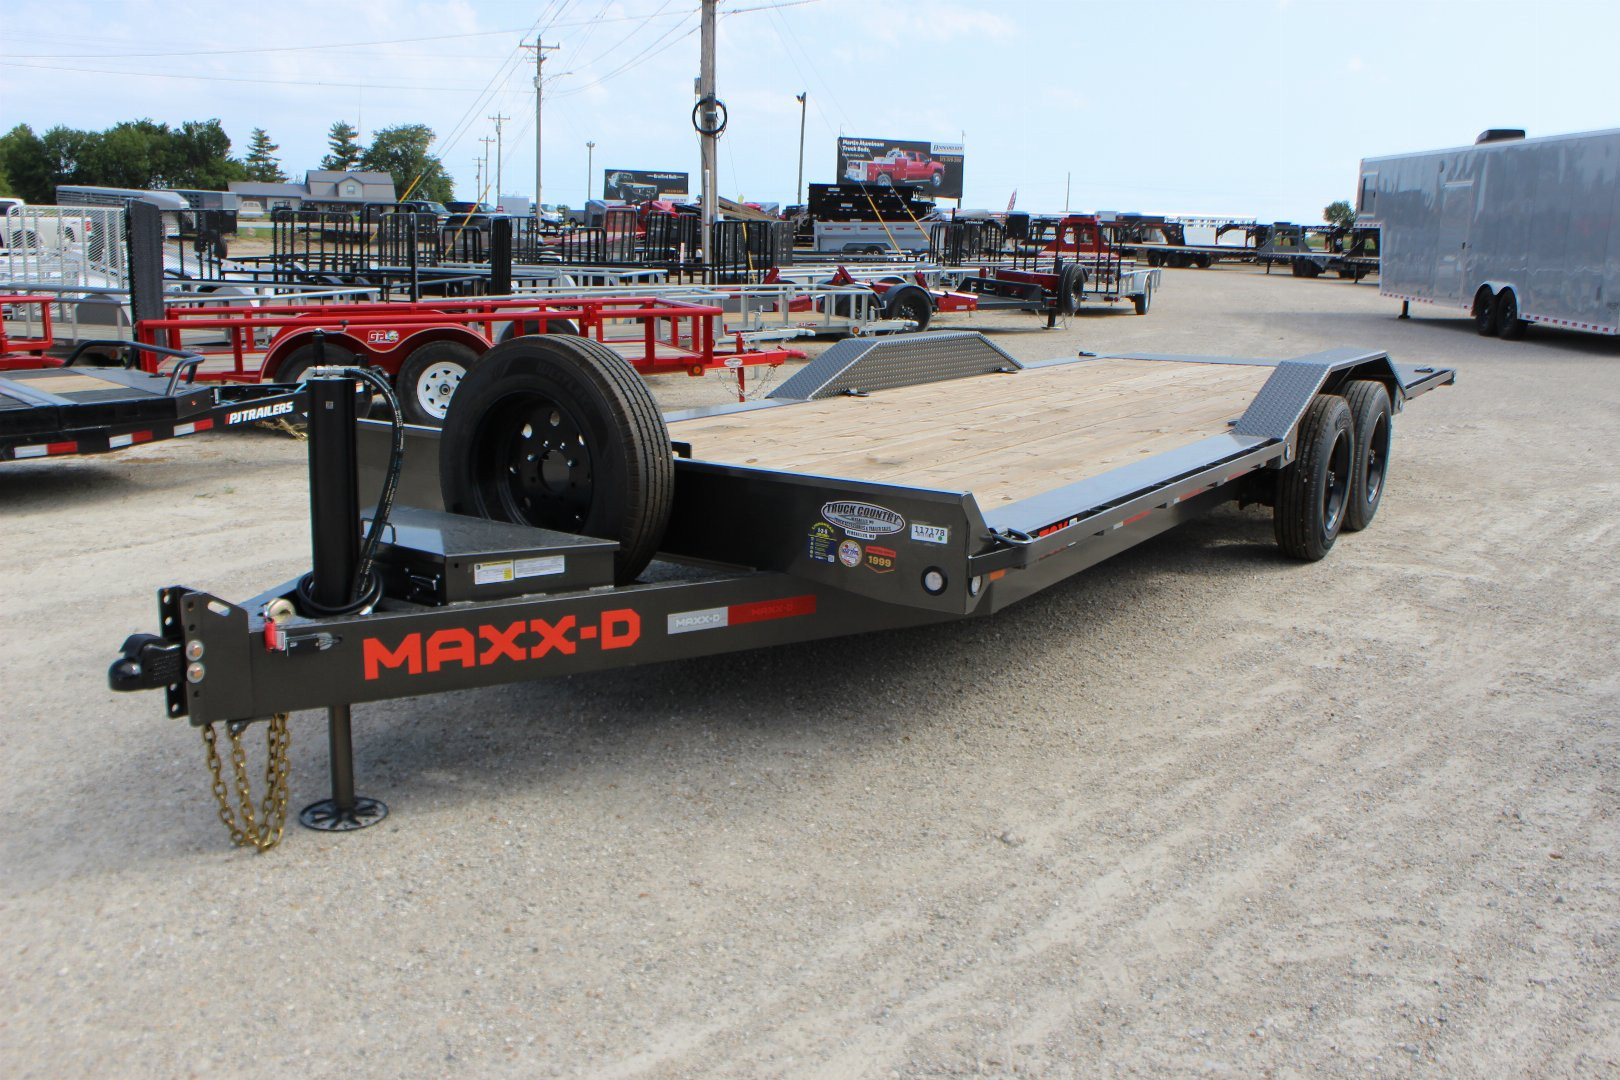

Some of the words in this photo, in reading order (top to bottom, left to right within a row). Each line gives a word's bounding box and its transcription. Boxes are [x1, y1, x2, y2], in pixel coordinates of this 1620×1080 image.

[826, 503, 856, 515] TRUCK
[857, 506, 900, 523] COUNTRY
[914, 525, 945, 537] 117178
[868, 555, 892, 568] 1999
[751, 604, 794, 617] MAXX-D
[675, 613, 720, 628] MAXX-D
[362, 608, 641, 681] MAXX-D
